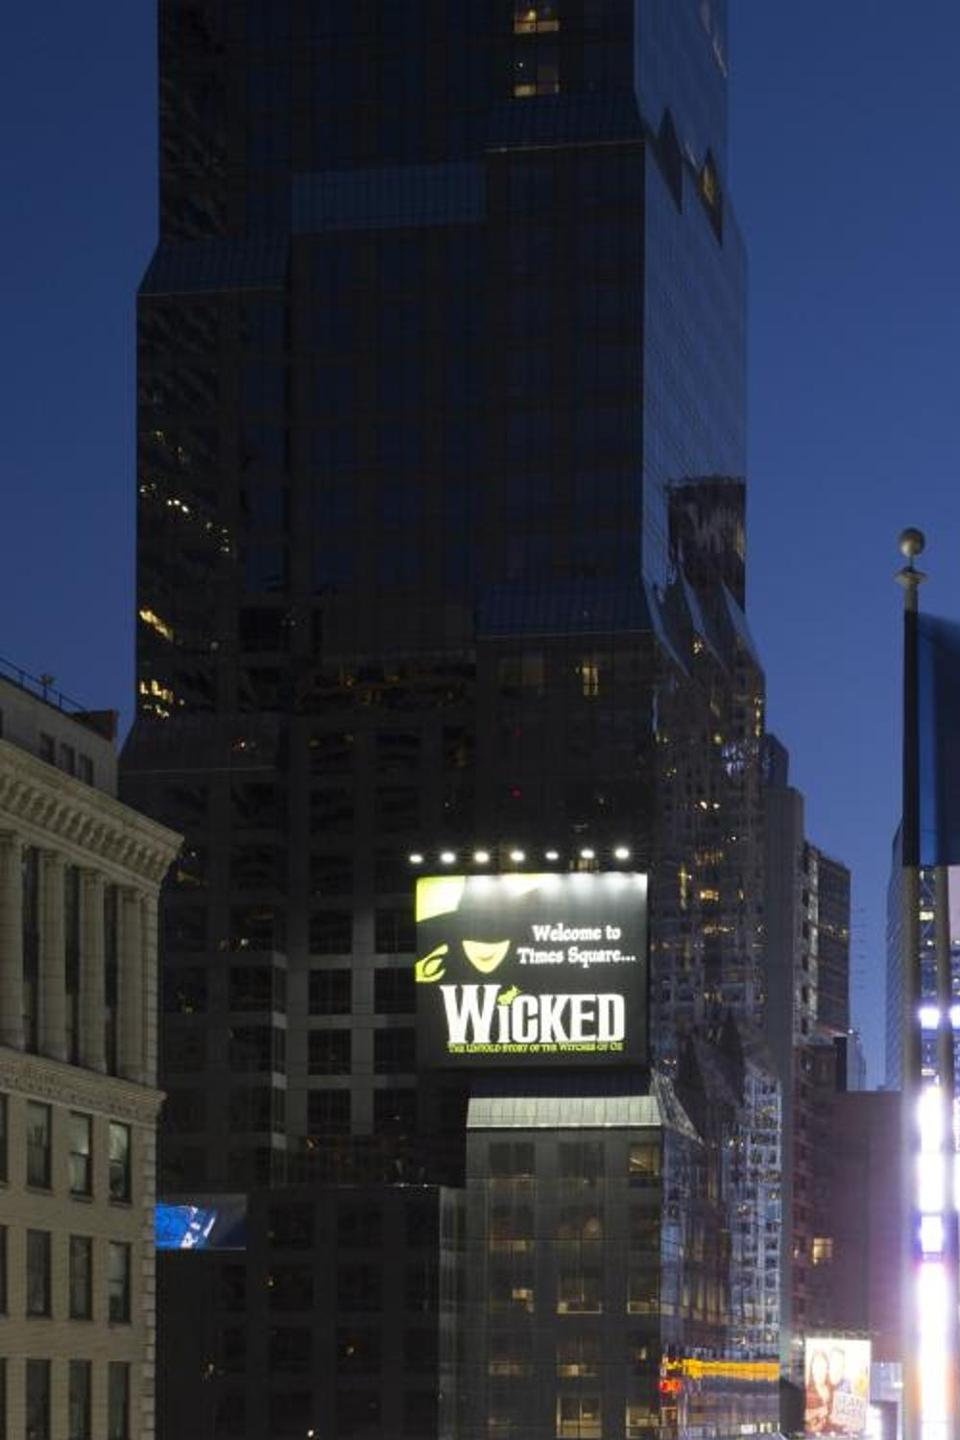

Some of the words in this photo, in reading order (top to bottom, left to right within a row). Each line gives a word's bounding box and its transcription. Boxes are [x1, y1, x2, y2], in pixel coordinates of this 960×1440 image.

[532, 923, 601, 942] Welcome
[606, 925, 622, 940] to
[517, 948, 563, 965] Times
[567, 948, 636, 968] Square...
